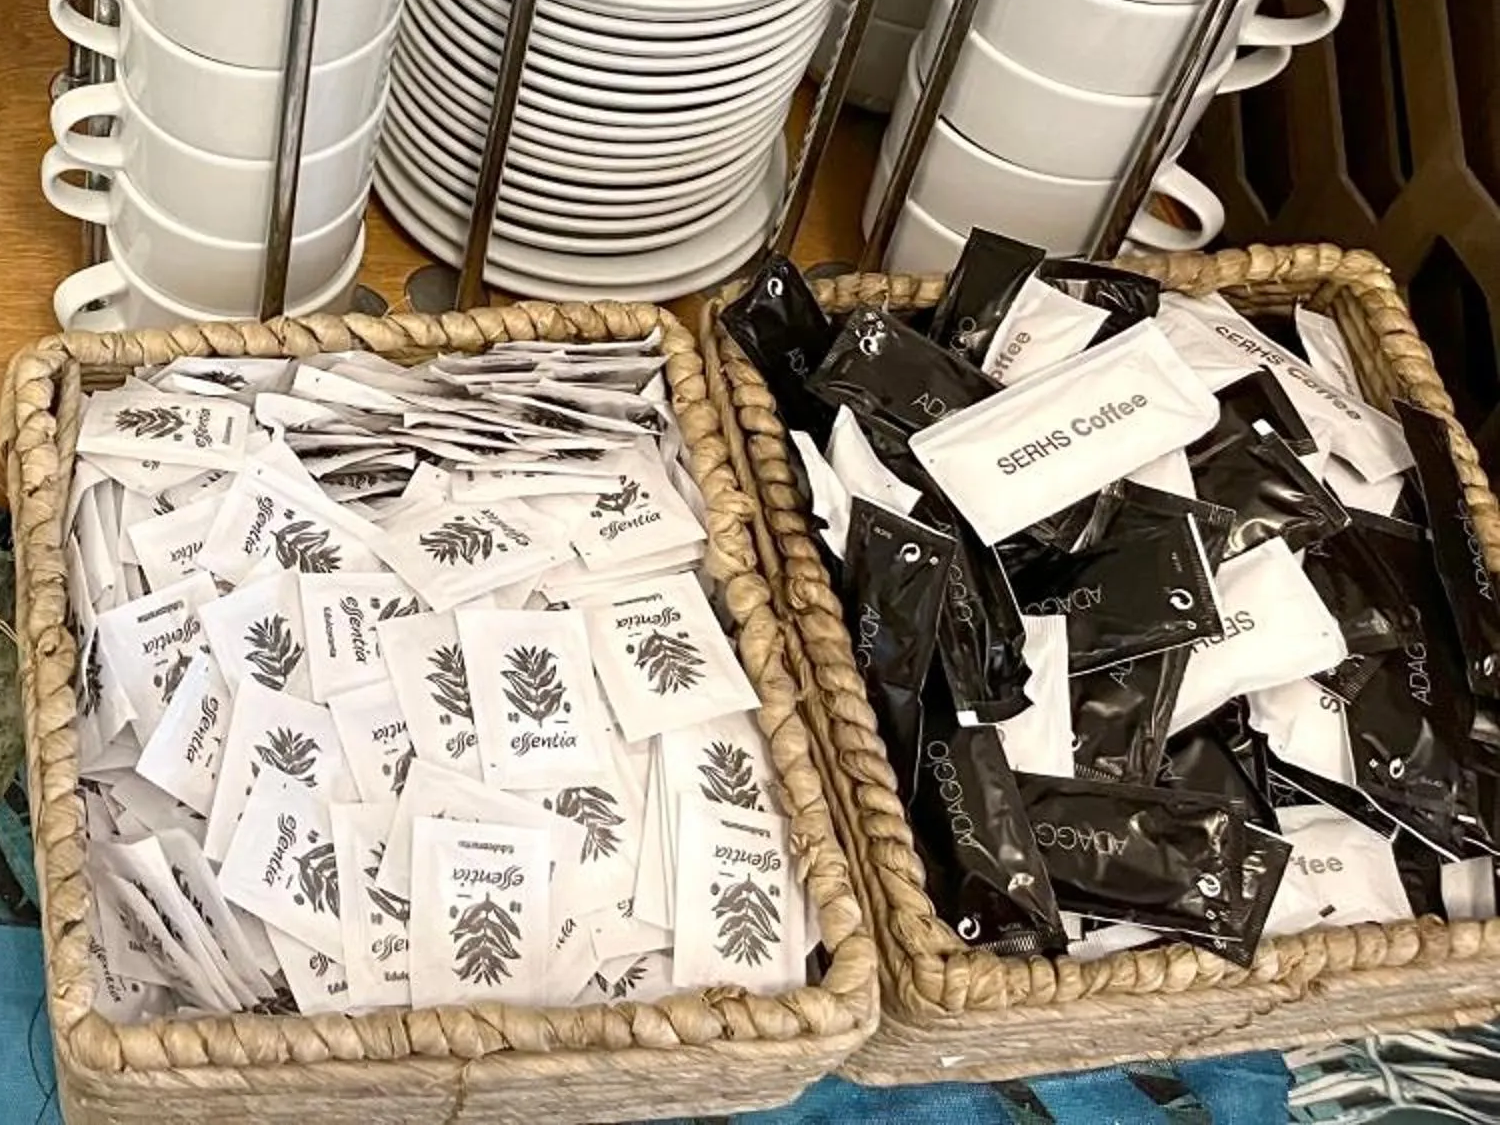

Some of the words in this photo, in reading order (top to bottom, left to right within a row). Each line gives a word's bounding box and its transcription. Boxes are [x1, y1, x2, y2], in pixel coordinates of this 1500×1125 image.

[990, 330, 1032, 379] offee
[996, 429, 1072, 477] SERHS
[1070, 392, 1149, 438] Coffee
[925, 740, 979, 849] ADAGGIO
[1036, 822, 1128, 857] ADAGG
